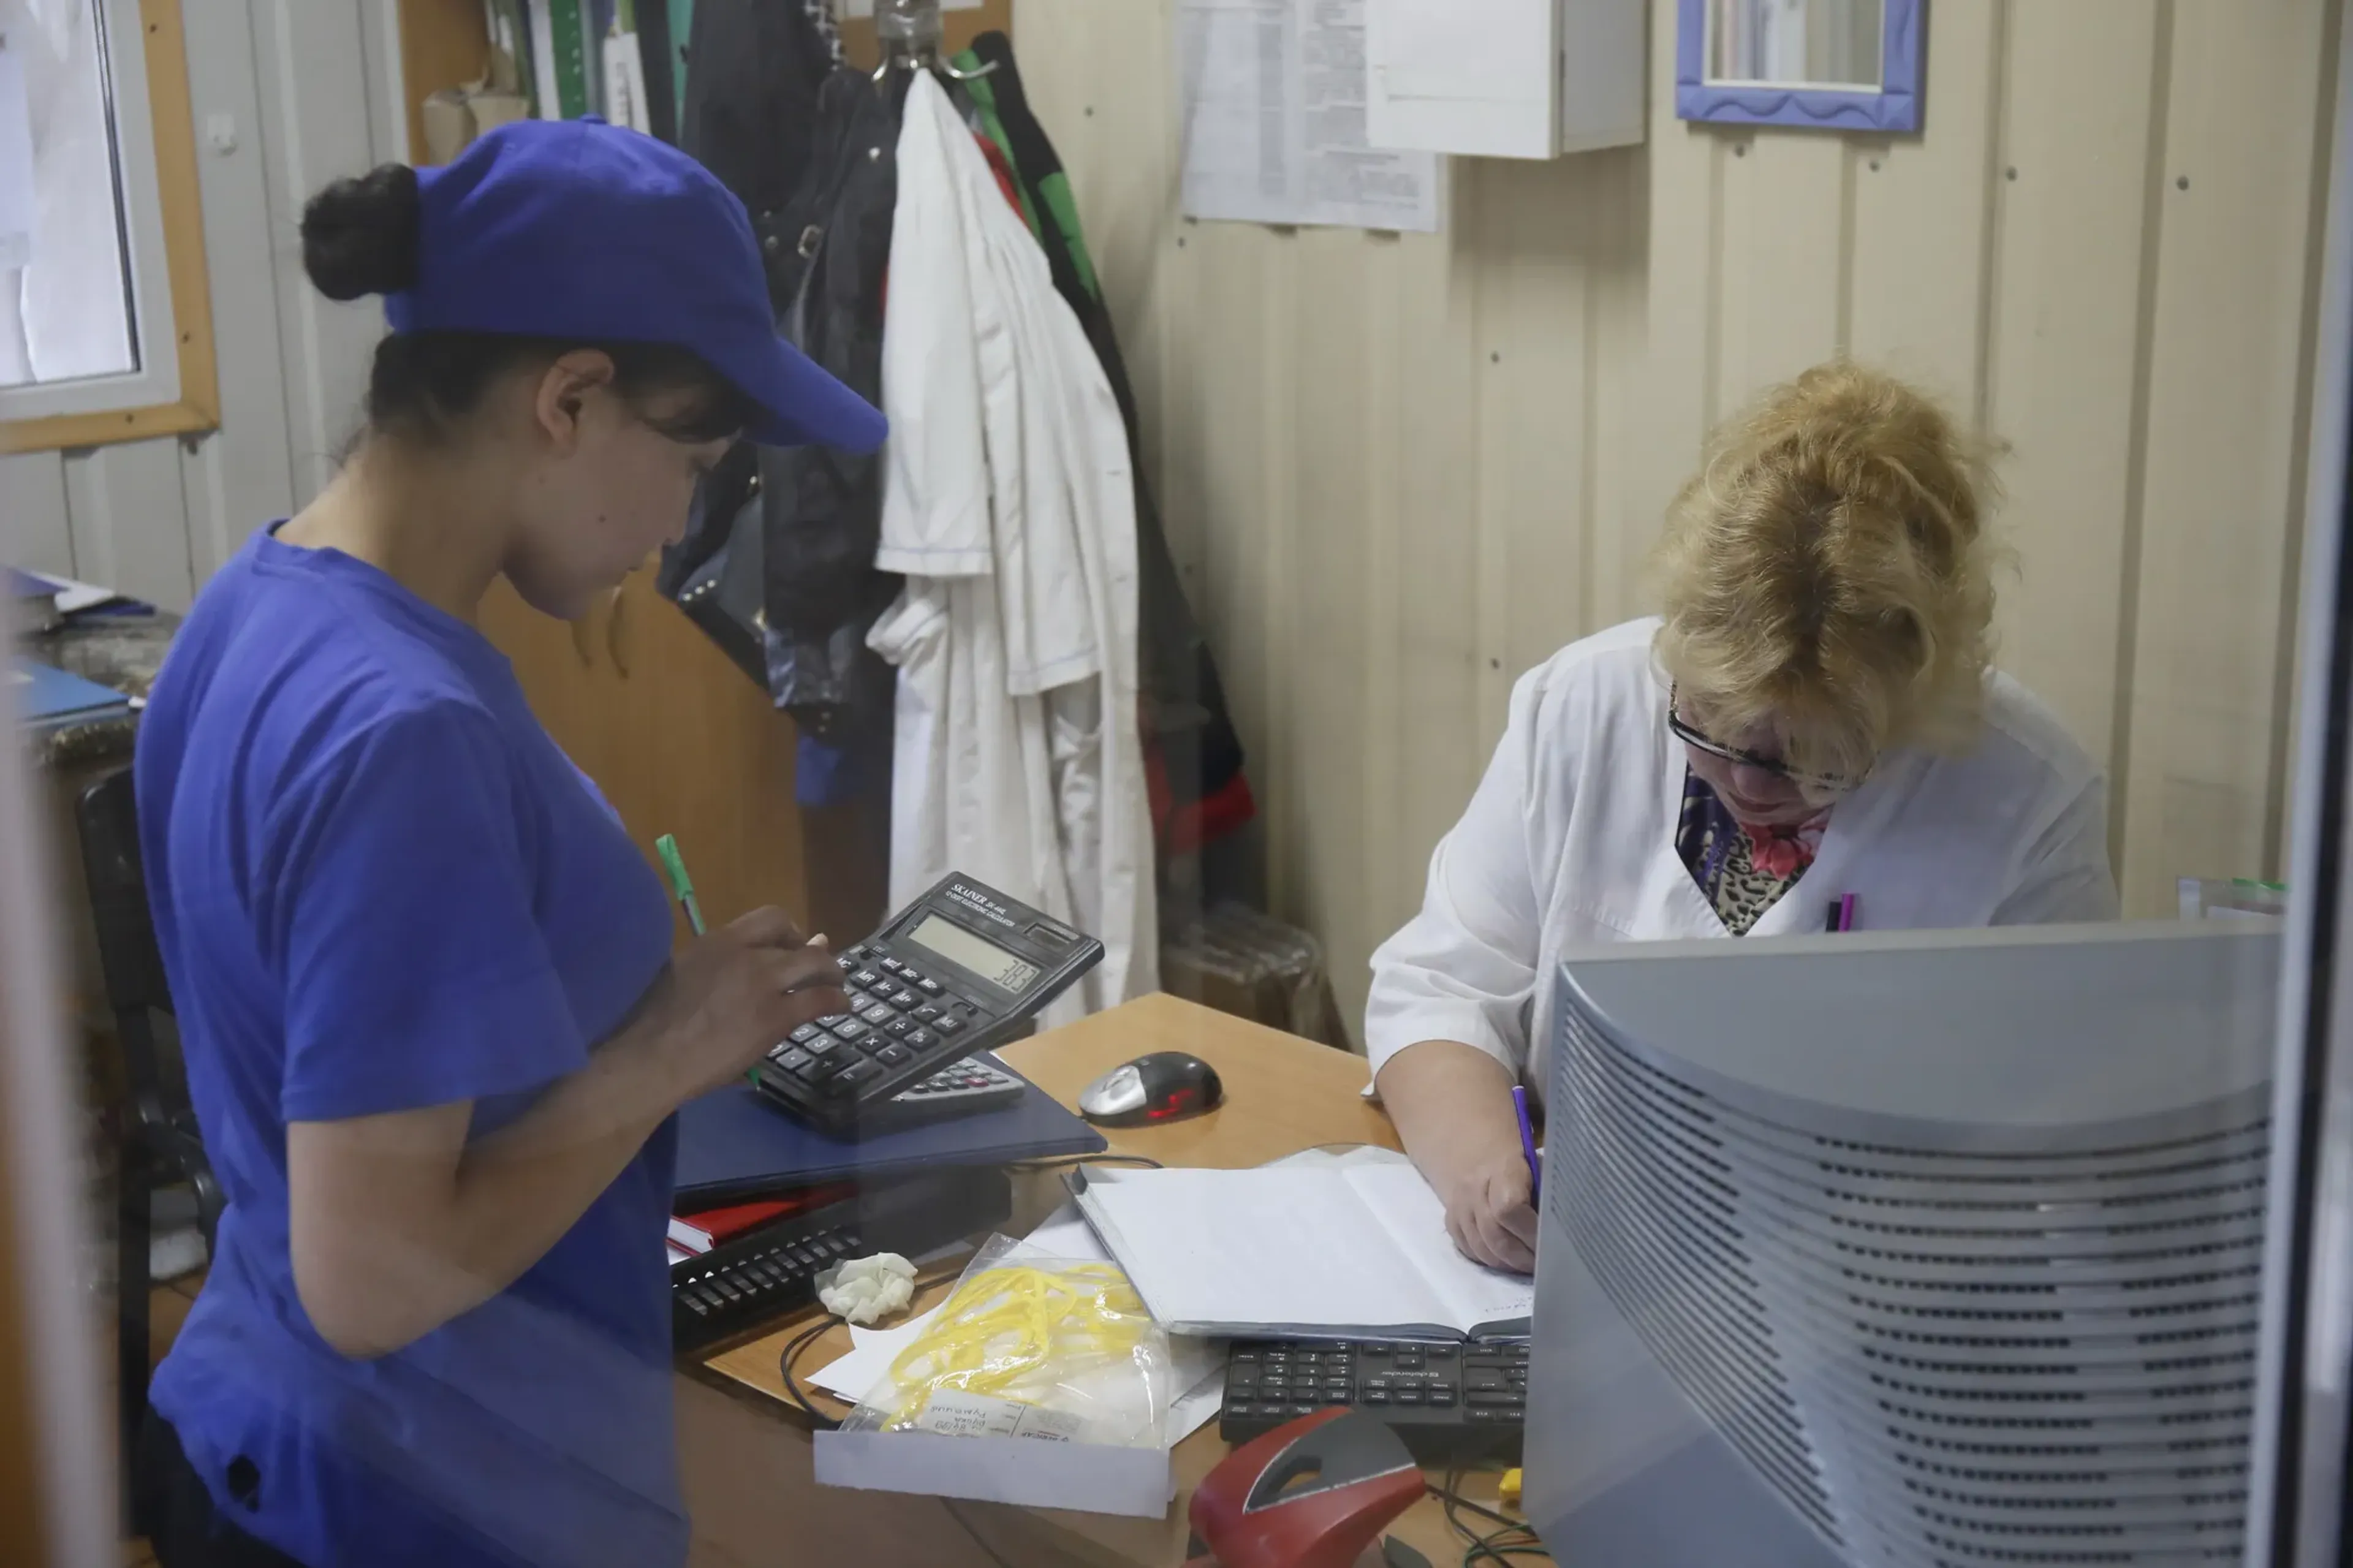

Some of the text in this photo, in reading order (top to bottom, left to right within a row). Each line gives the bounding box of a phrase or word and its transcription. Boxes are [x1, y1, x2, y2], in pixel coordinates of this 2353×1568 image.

[950, 884, 988, 904] SKAINER
[986, 911, 1015, 927] CALCULATOR
[993, 958, 1037, 991] 383
[795, 1028, 809, 1037] 2
[843, 1024, 856, 1032] 6
[814, 1039, 828, 1048] 3
